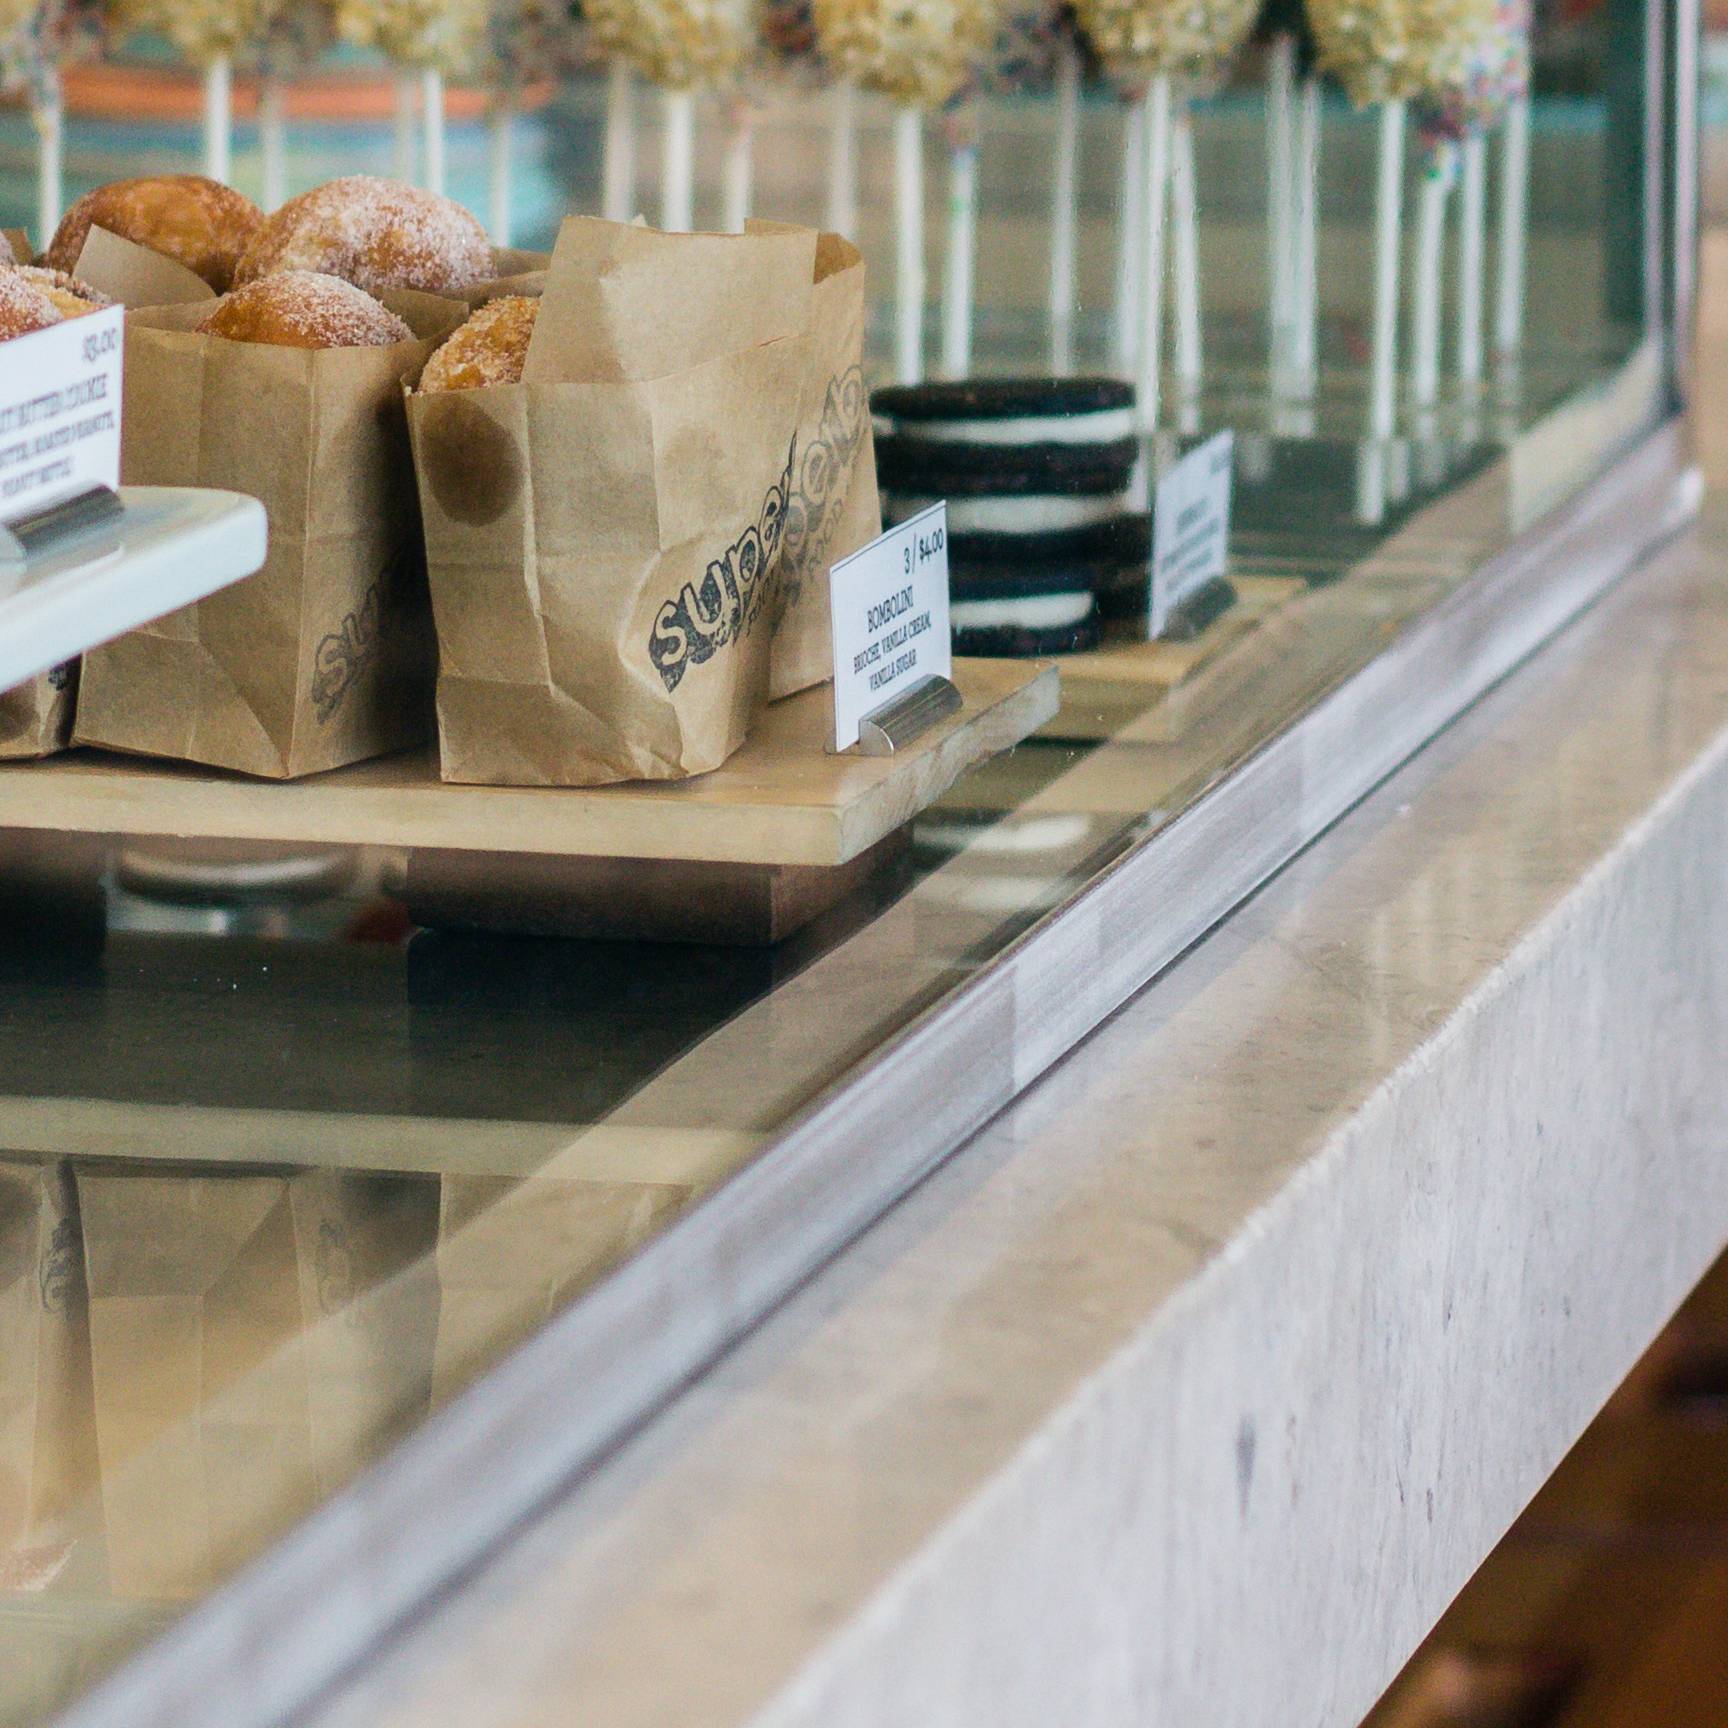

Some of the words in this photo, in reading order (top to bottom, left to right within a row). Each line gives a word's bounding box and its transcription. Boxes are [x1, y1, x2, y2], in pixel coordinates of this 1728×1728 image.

[903, 545, 910, 575] 3
[919, 527, 944, 564] $4.00
[867, 584, 913, 633] BOMBOLINI
[881, 624, 908, 655] VANILLA
[868, 661, 896, 692] VANILLA
[896, 647, 916, 675] SUGAR
